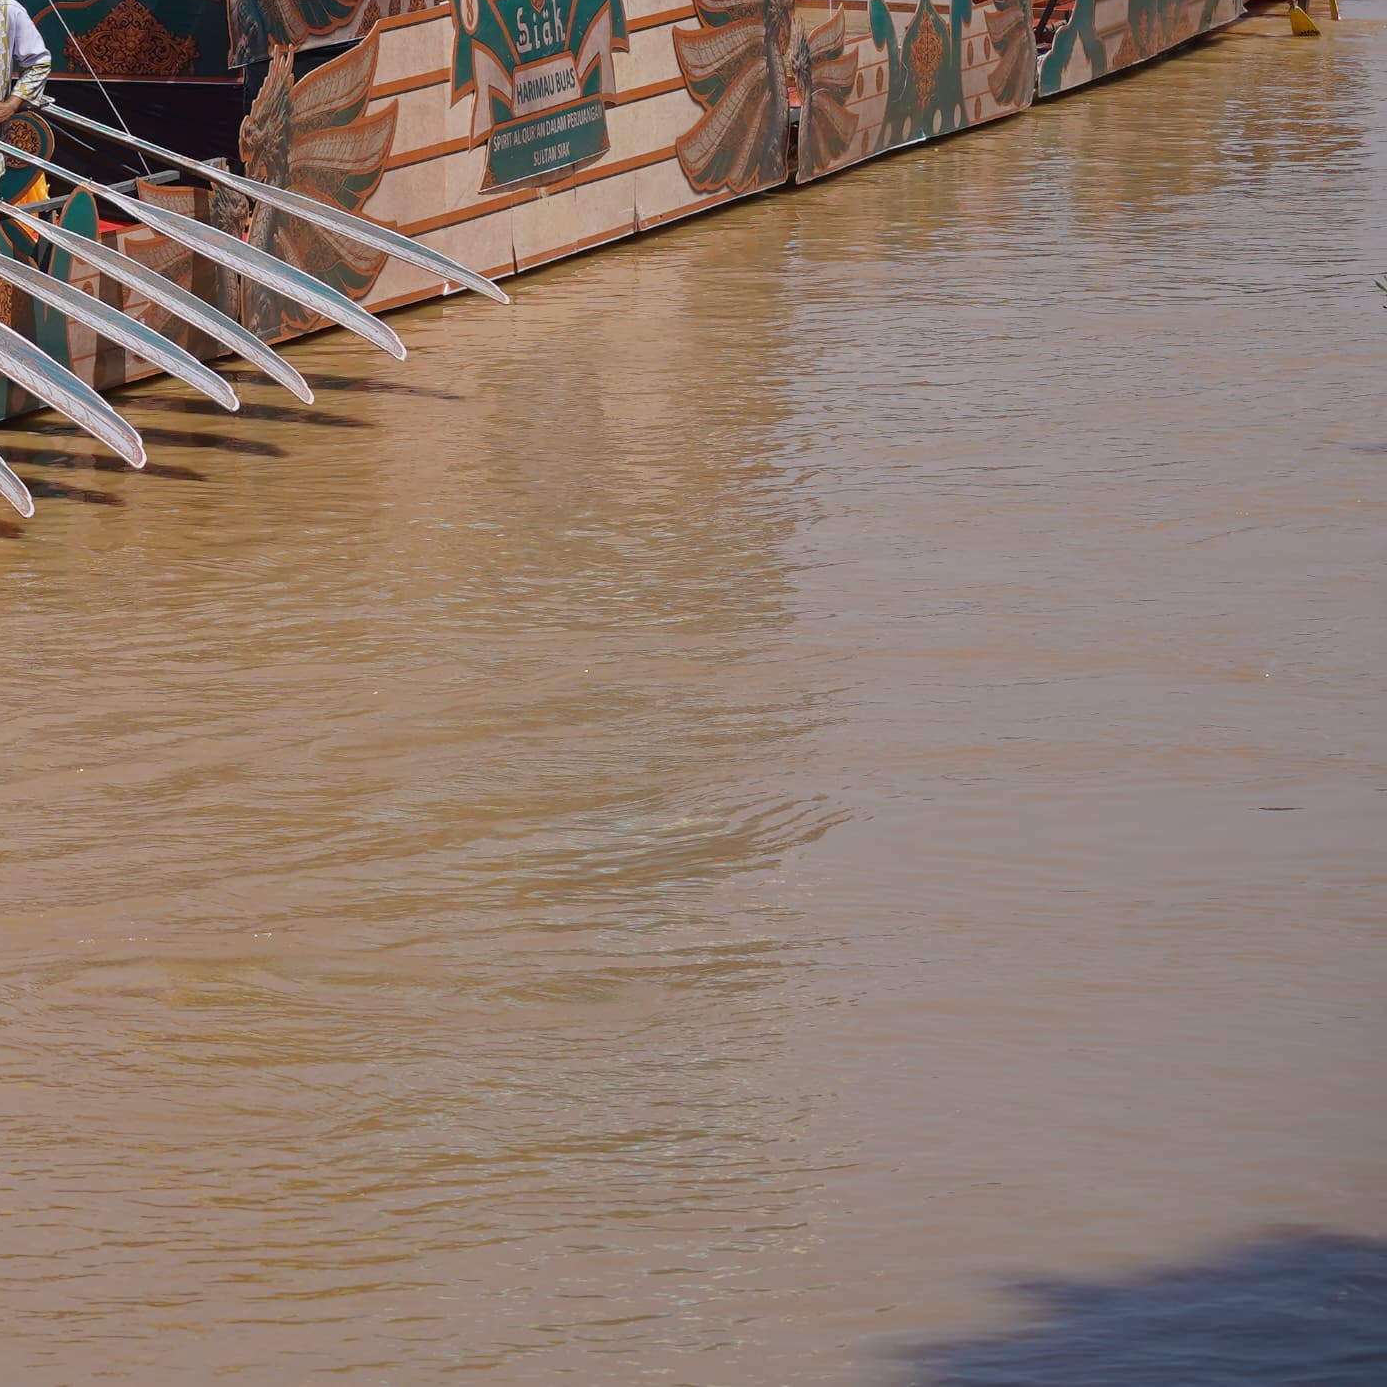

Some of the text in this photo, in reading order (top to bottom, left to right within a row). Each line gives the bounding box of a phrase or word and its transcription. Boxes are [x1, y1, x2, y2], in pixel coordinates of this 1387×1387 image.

[516, 67, 577, 105] HARIMAU BUAS
[493, 131, 513, 153] SPIRIT
[513, 129, 523, 146] AL
[546, 114, 568, 136] DALAM
[567, 101, 603, 129] PERJUANGAN
[532, 141, 572, 167] SULTAN SIAK
